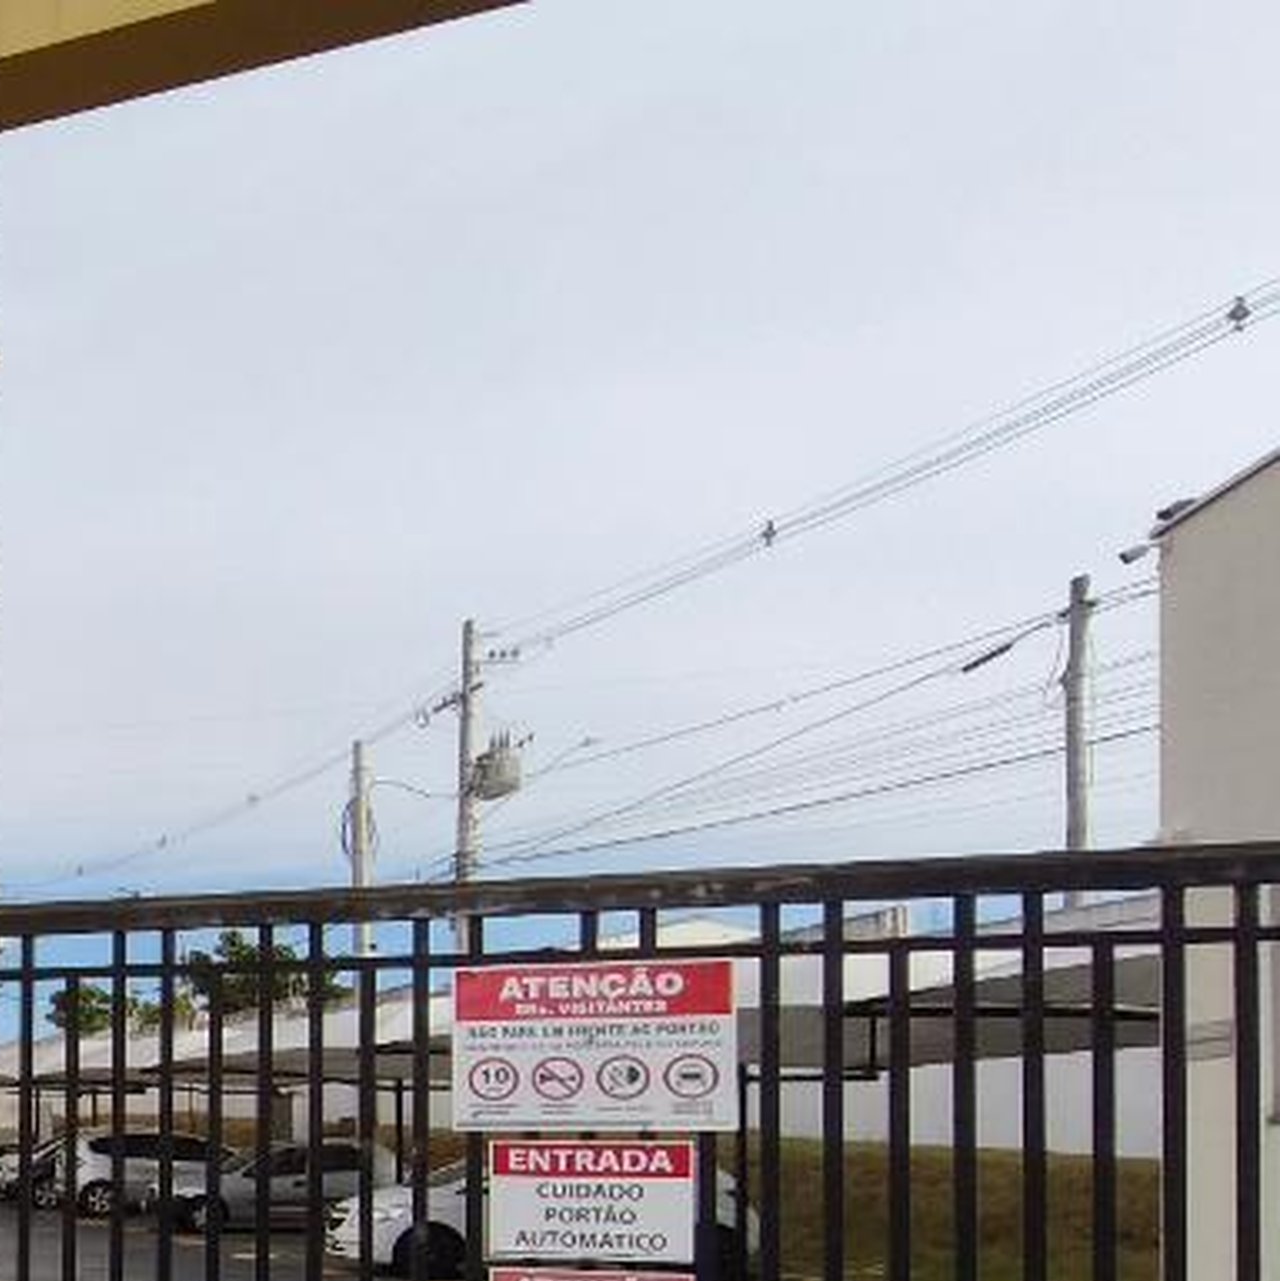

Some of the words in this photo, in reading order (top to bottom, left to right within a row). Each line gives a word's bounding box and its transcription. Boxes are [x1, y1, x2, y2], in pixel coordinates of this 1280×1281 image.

[499, 968, 684, 1001] ATENÇÃO
[559, 1000, 667, 1015] VISITANTES
[481, 1064, 510, 1084] 10
[508, 1149, 674, 1173] ENTRADA
[536, 1182, 644, 1201] CUIDADO
[544, 1204, 637, 1225] PORTÃO
